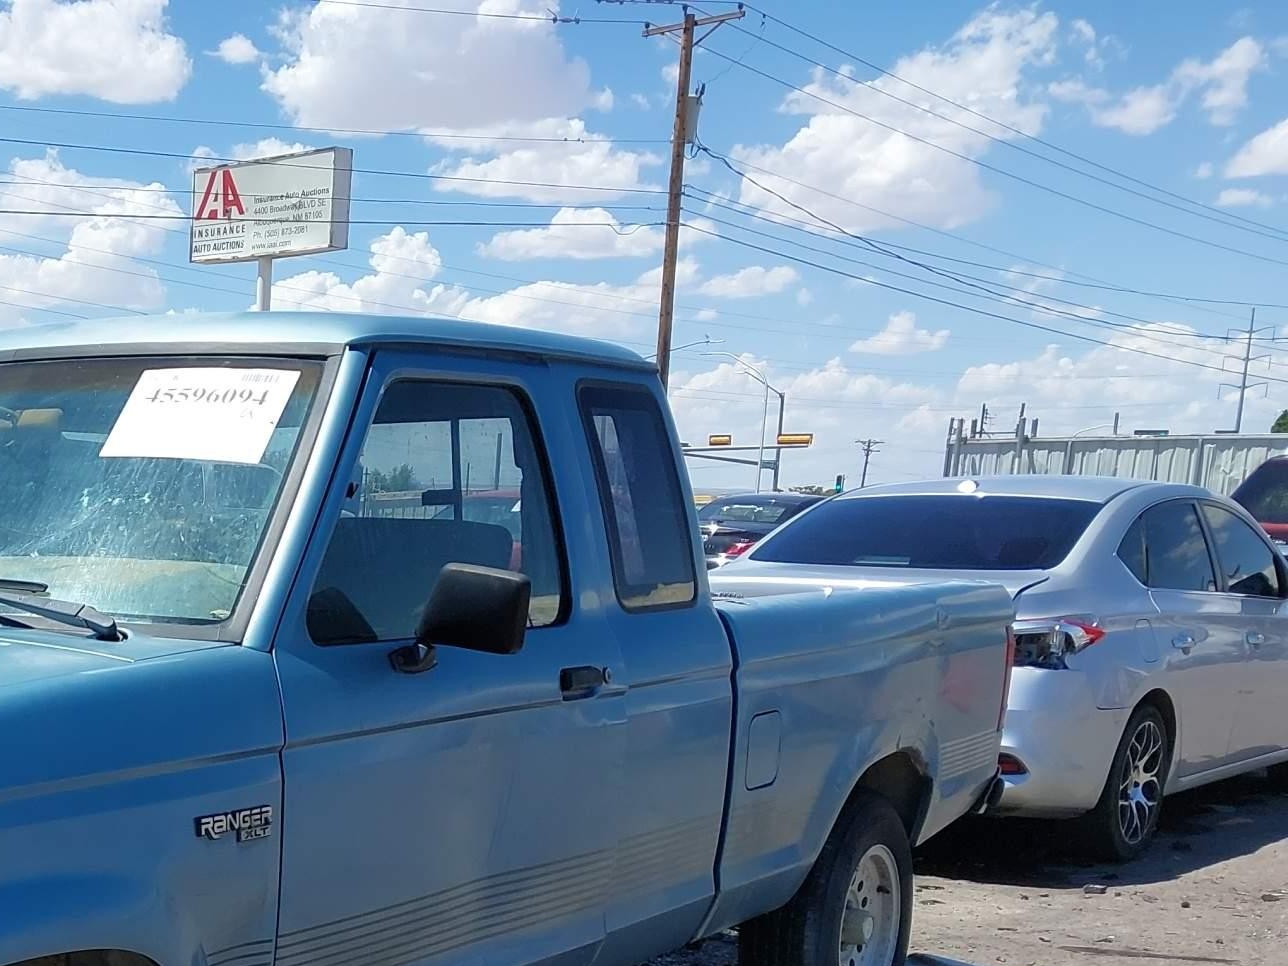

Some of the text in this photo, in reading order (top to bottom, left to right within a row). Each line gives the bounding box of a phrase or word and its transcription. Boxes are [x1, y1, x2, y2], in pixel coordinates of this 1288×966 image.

[254, 187, 330, 204] Insurance Auto Auctions
[253, 206, 269, 215] 4400
[298, 199, 317, 210] BLVD
[317, 198, 327, 208] SE
[292, 213, 304, 221] NM
[194, 224, 245, 239] INSURANCE
[193, 239, 245, 254] AUTO AUCTIONS
[146, 388, 269, 405] 45596094
